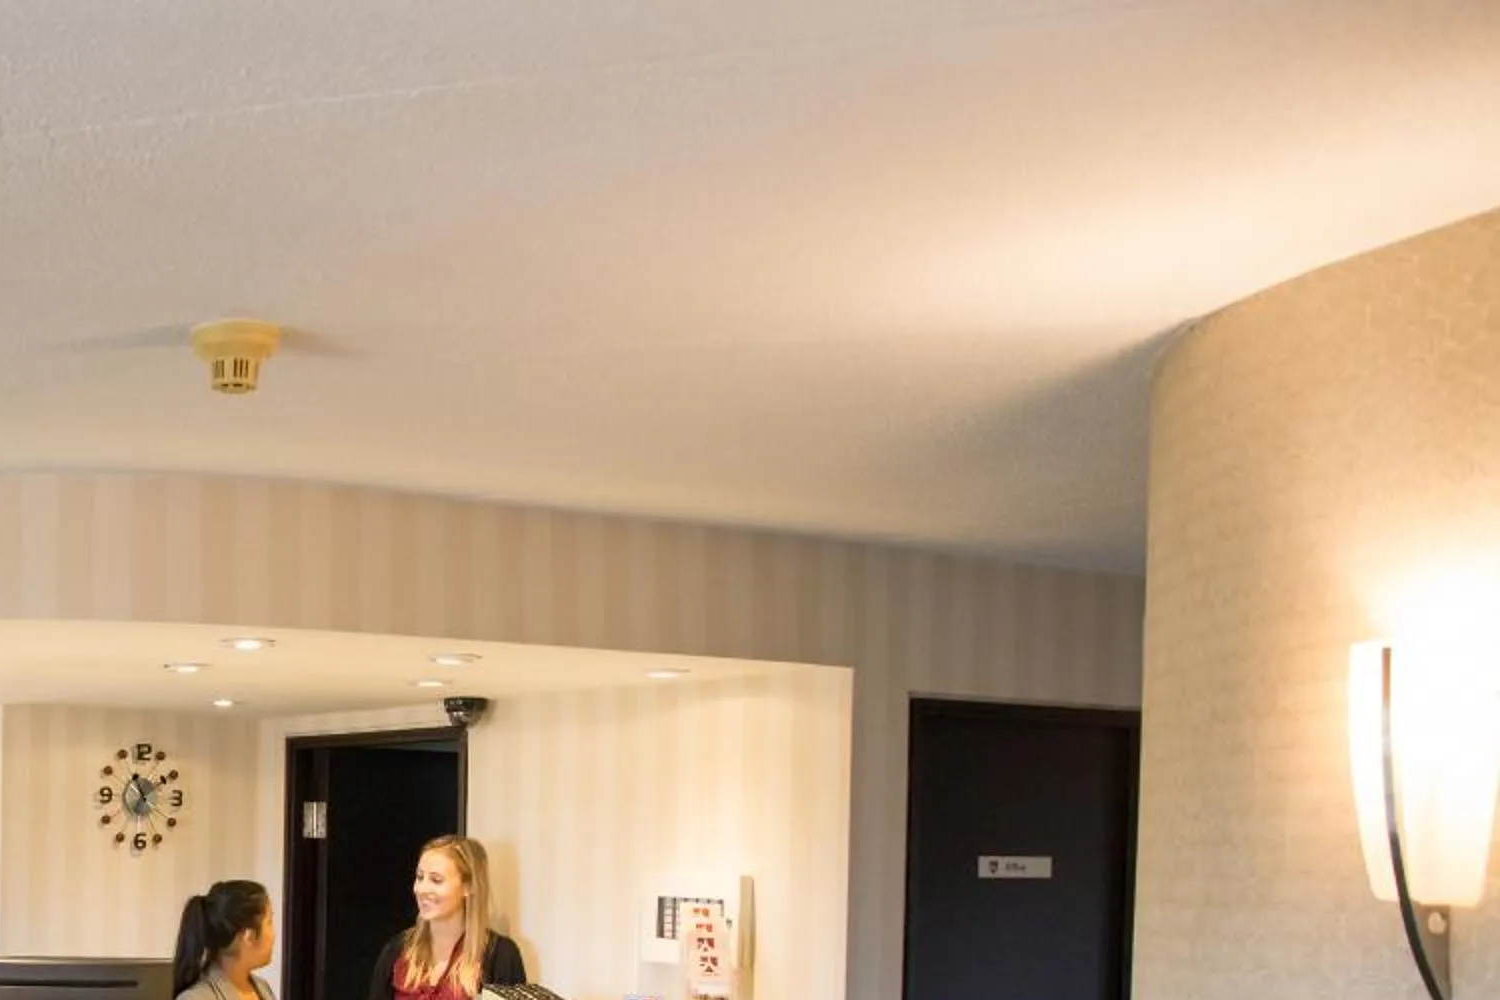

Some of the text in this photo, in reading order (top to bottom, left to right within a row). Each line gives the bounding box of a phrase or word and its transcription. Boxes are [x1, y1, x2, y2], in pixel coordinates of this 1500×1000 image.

[136, 743, 152, 761] 12
[99, 786, 113, 804] 9
[171, 789, 183, 807] 3
[133, 833, 147, 850] 6
